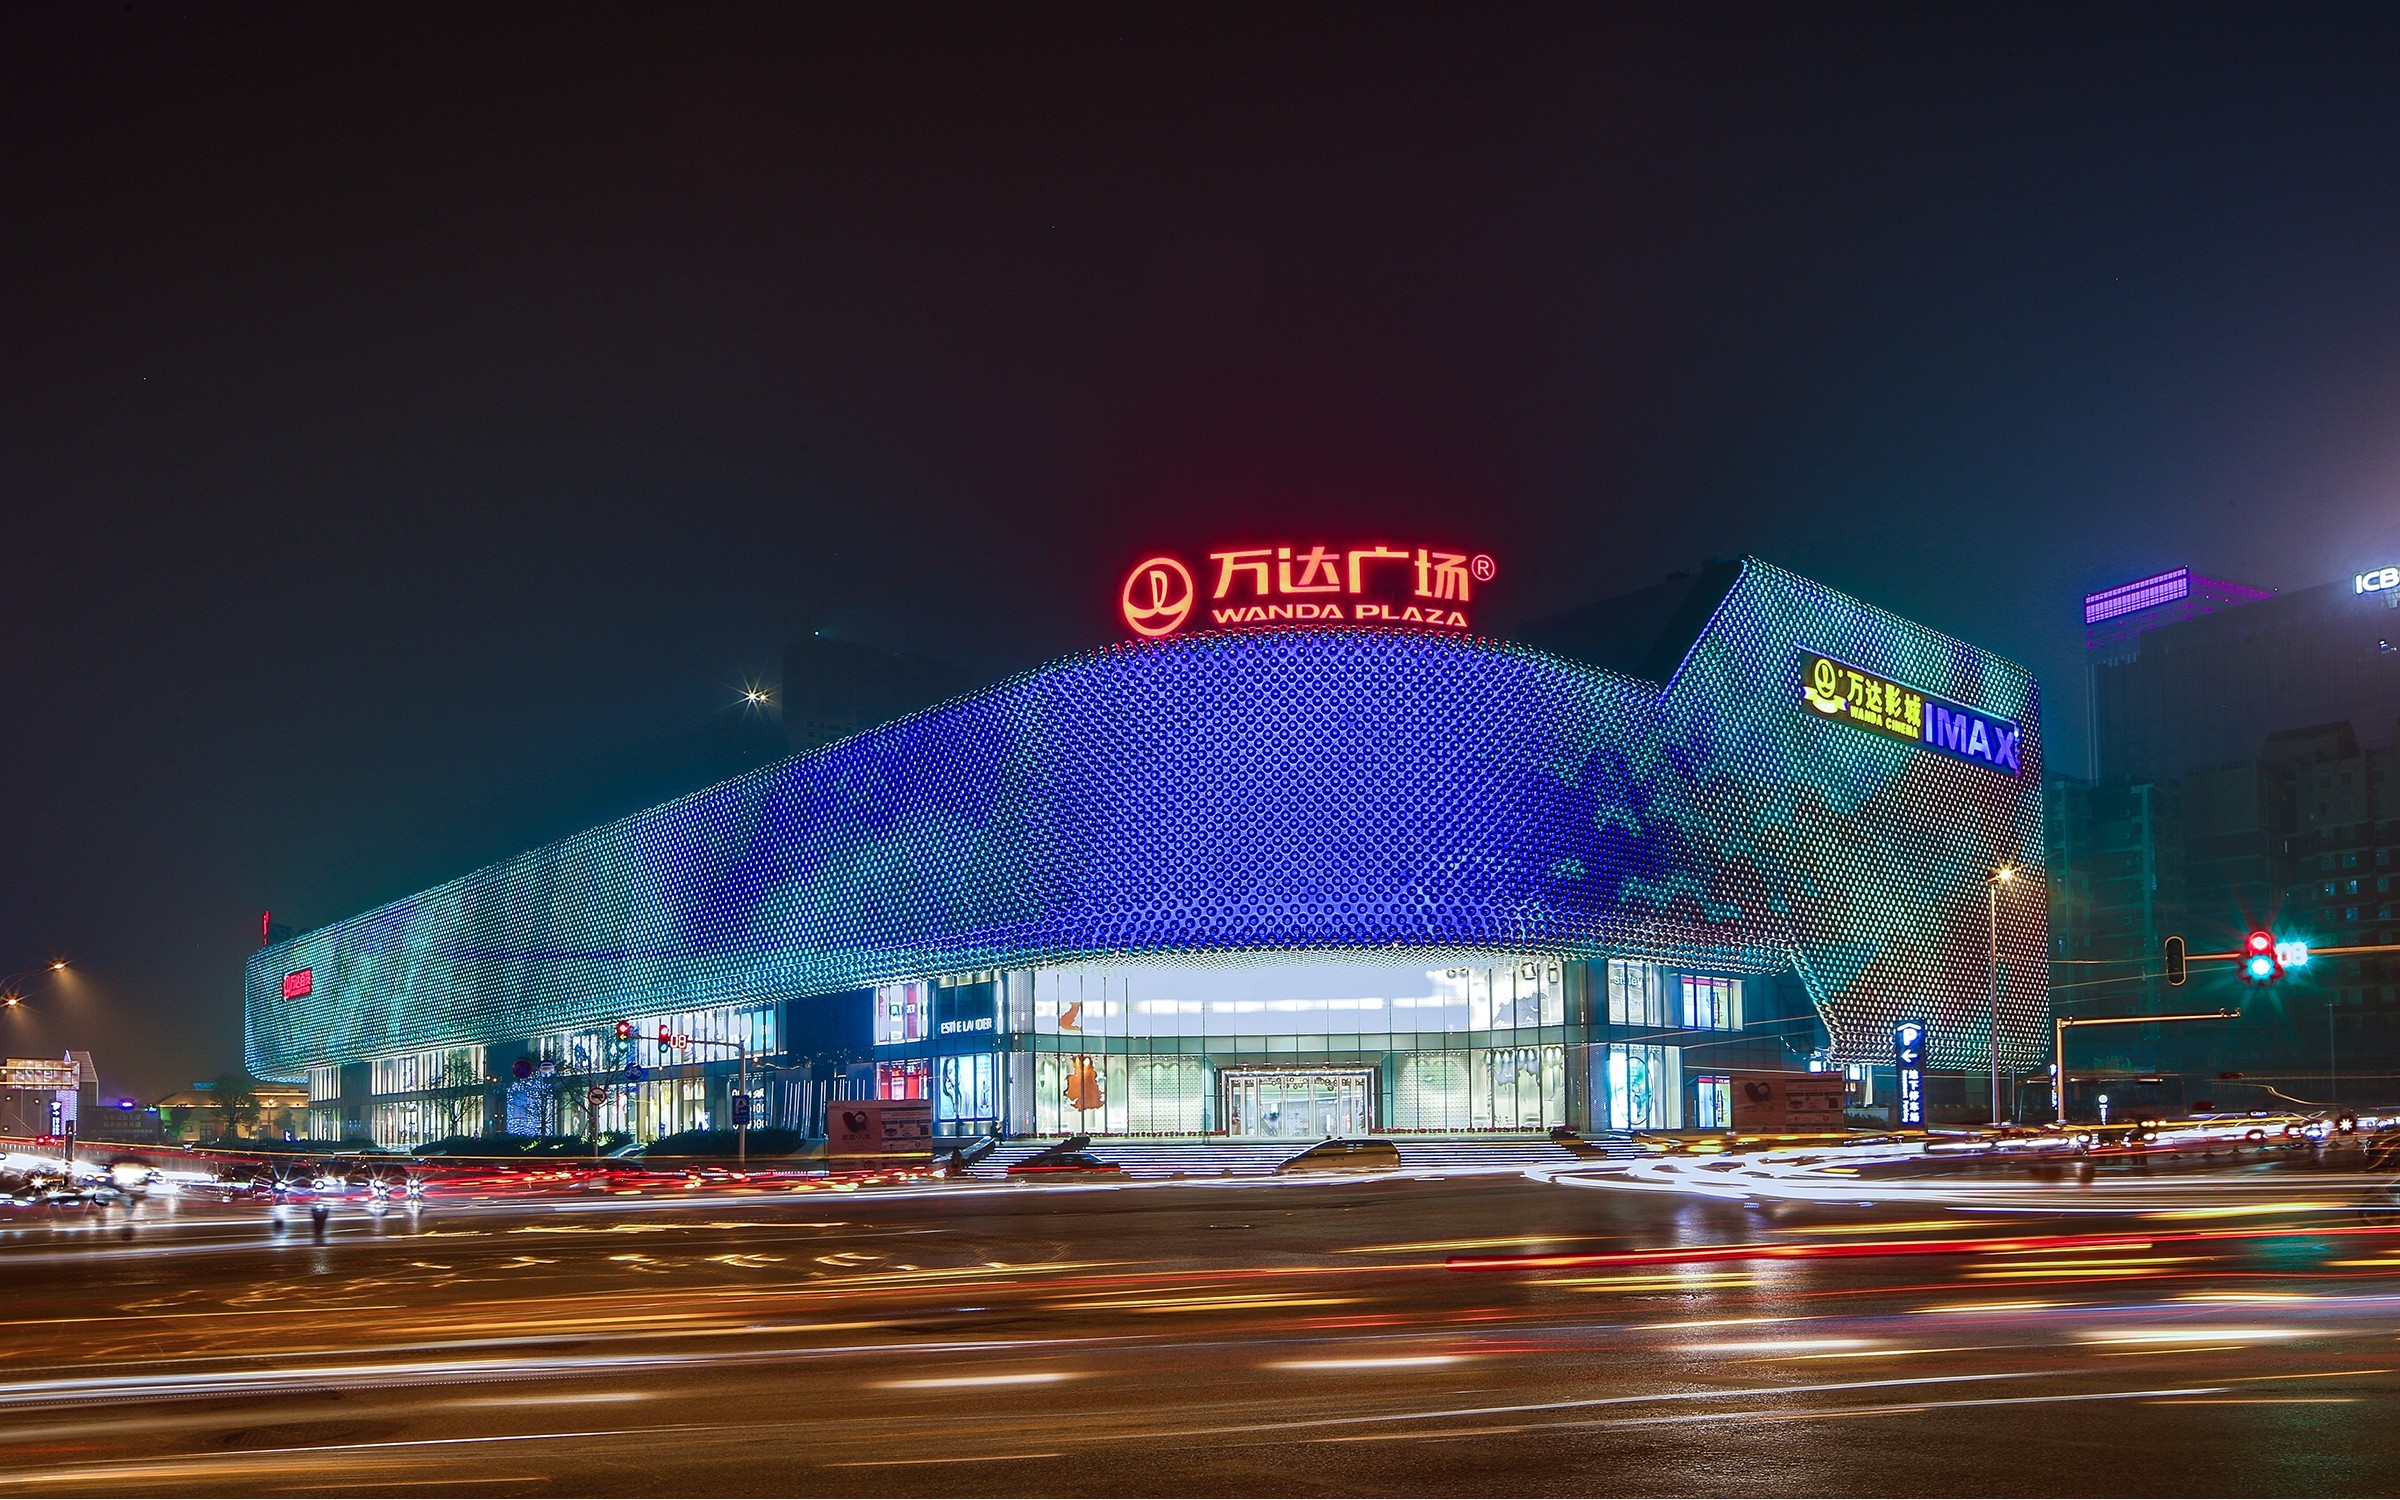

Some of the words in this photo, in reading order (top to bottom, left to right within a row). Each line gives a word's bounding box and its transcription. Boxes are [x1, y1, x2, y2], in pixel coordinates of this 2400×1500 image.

[1210, 546, 1469, 601] 万达广场
[1212, 604, 1344, 624] WANDA
[1355, 604, 1468, 627] PLAZA
[1846, 671, 1922, 727] 万达影城
[1850, 705, 1883, 727] WANDA
[1885, 717, 1918, 739] CINEMA
[1924, 702, 2018, 770] IMAX
[670, 1036, 687, 1049] 08
[1902, 1028, 1918, 1046] P
